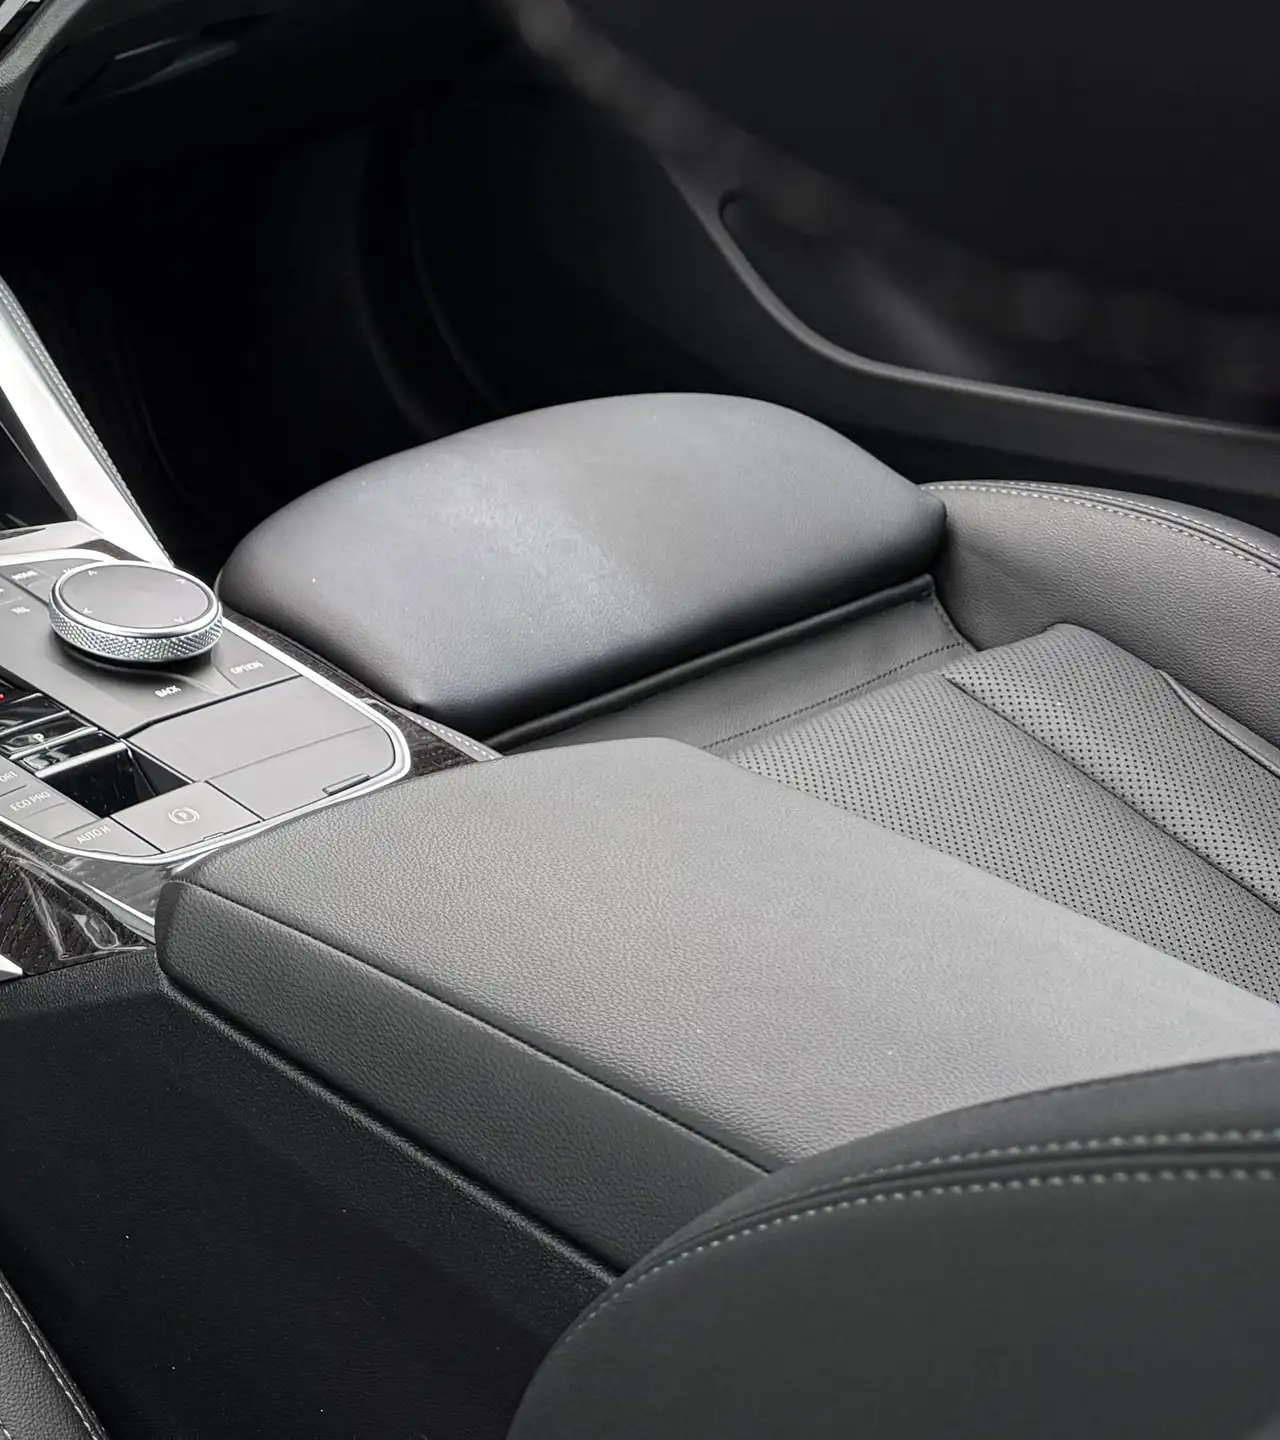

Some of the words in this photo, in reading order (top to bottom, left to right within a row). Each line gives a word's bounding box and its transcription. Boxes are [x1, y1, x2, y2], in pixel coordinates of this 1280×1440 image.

[154, 684, 182, 698] BACK
[10, 798, 31, 812] ECO
[31, 790, 52, 804] PRO
[76, 829, 102, 844] AUTO
[100, 825, 112, 835] H
